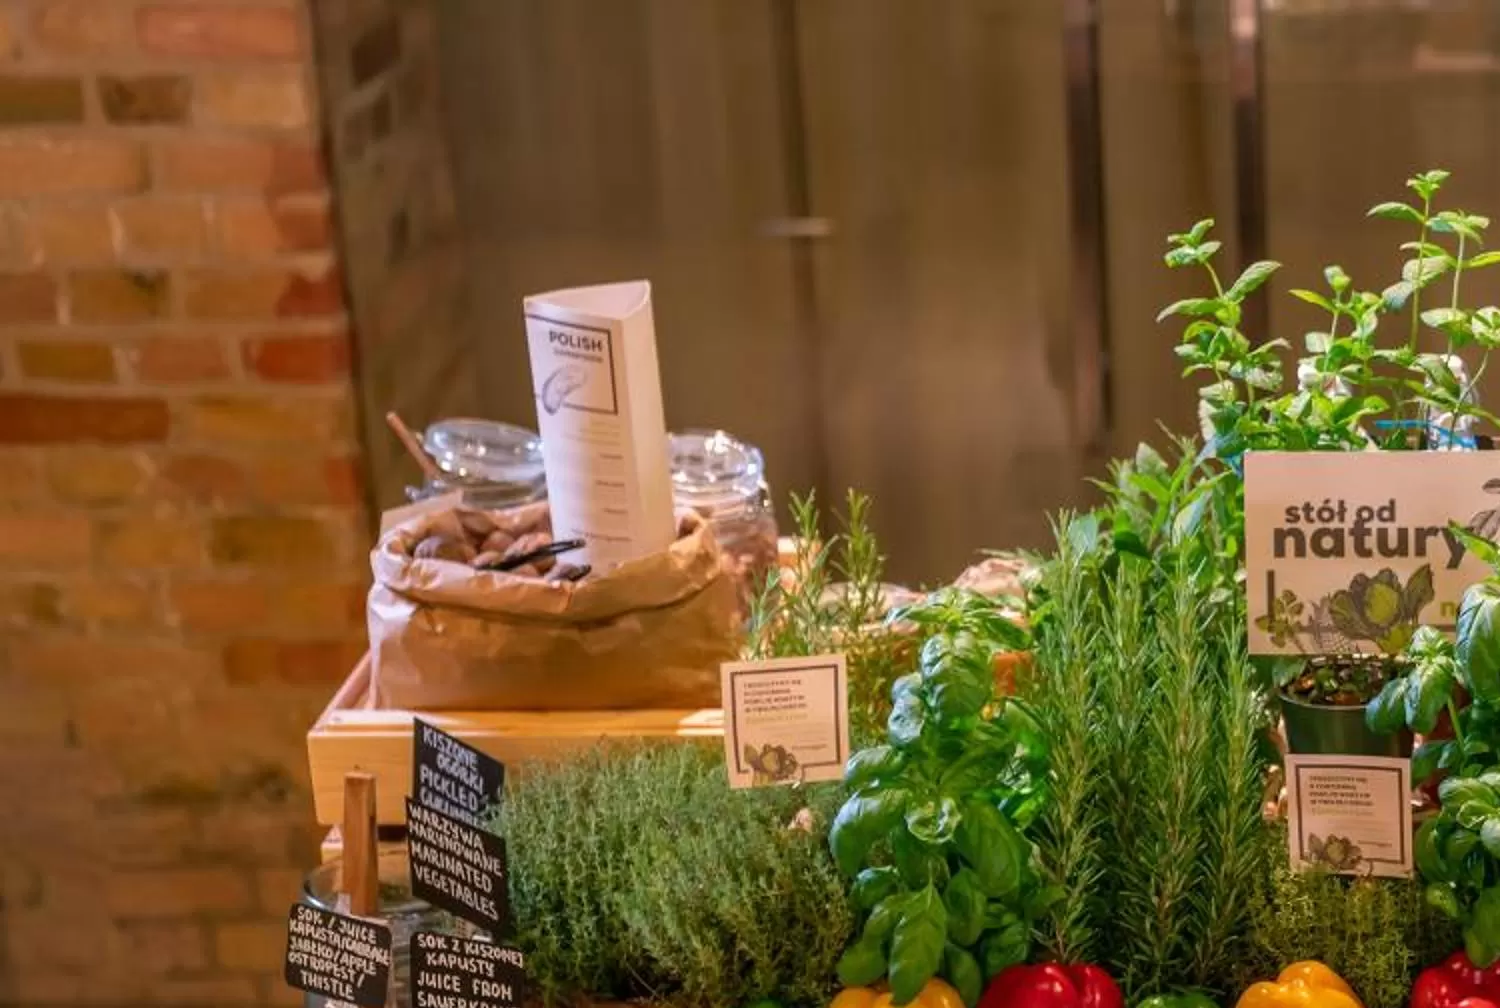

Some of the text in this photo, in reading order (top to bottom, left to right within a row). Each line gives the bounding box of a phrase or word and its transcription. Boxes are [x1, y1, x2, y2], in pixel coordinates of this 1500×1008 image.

[549, 330, 603, 352] POLISH
[1285, 499, 1396, 523] stół od
[1273, 519, 1475, 569] natury
[420, 764, 479, 811] PICKLED
[409, 803, 484, 850] WARZYWA
[409, 820, 502, 876] MARYNOWANE
[411, 841, 492, 893] MARINATED
[414, 863, 499, 920] VEGETABLES
[339, 920, 376, 944] JUICE
[417, 934, 523, 968] SOK Z KISZONEJ
[426, 952, 495, 978] KAPUSTY
[301, 969, 355, 1001] THISTLE
[417, 970, 512, 1001] JUICE FROM
